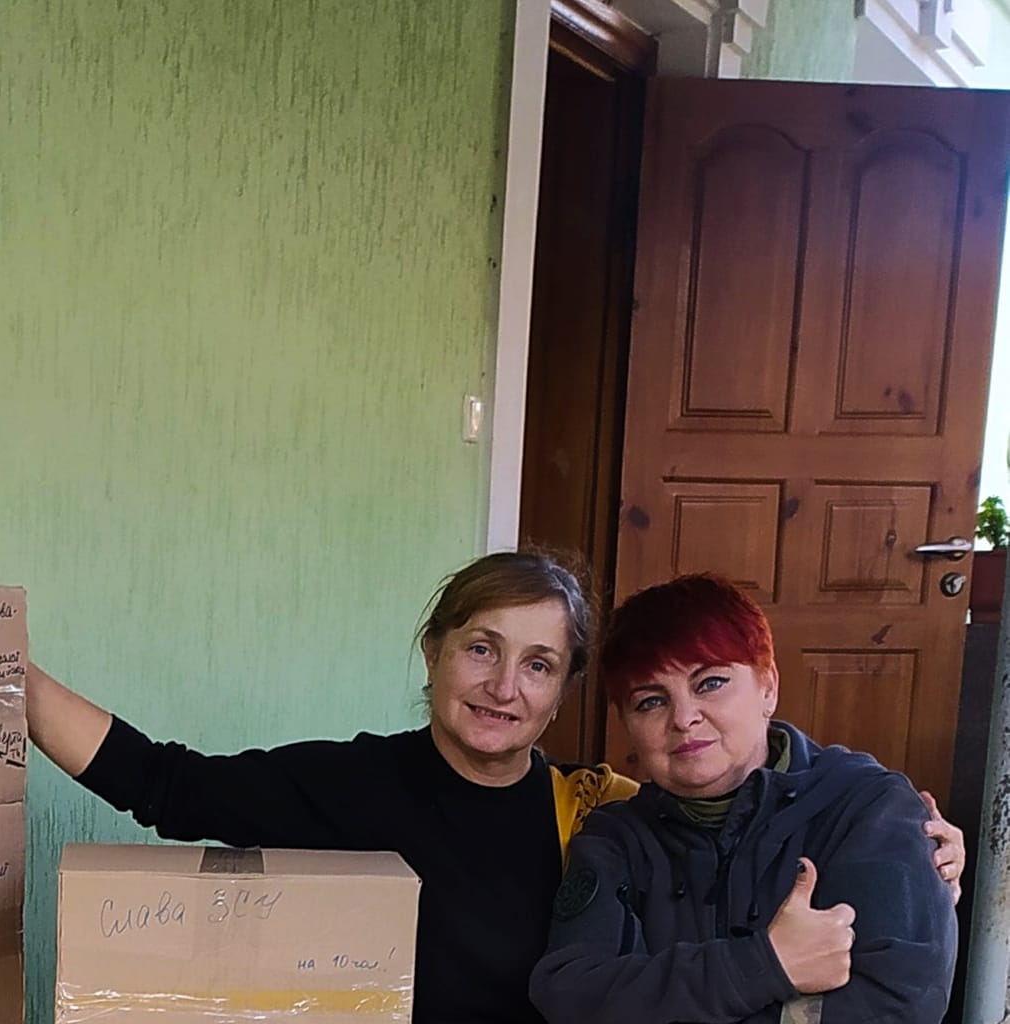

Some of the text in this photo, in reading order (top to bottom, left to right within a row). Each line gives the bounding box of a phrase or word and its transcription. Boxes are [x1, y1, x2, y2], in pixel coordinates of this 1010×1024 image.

[100, 888, 283, 939] Слава ЗСУ
[297, 957, 316, 971] на
